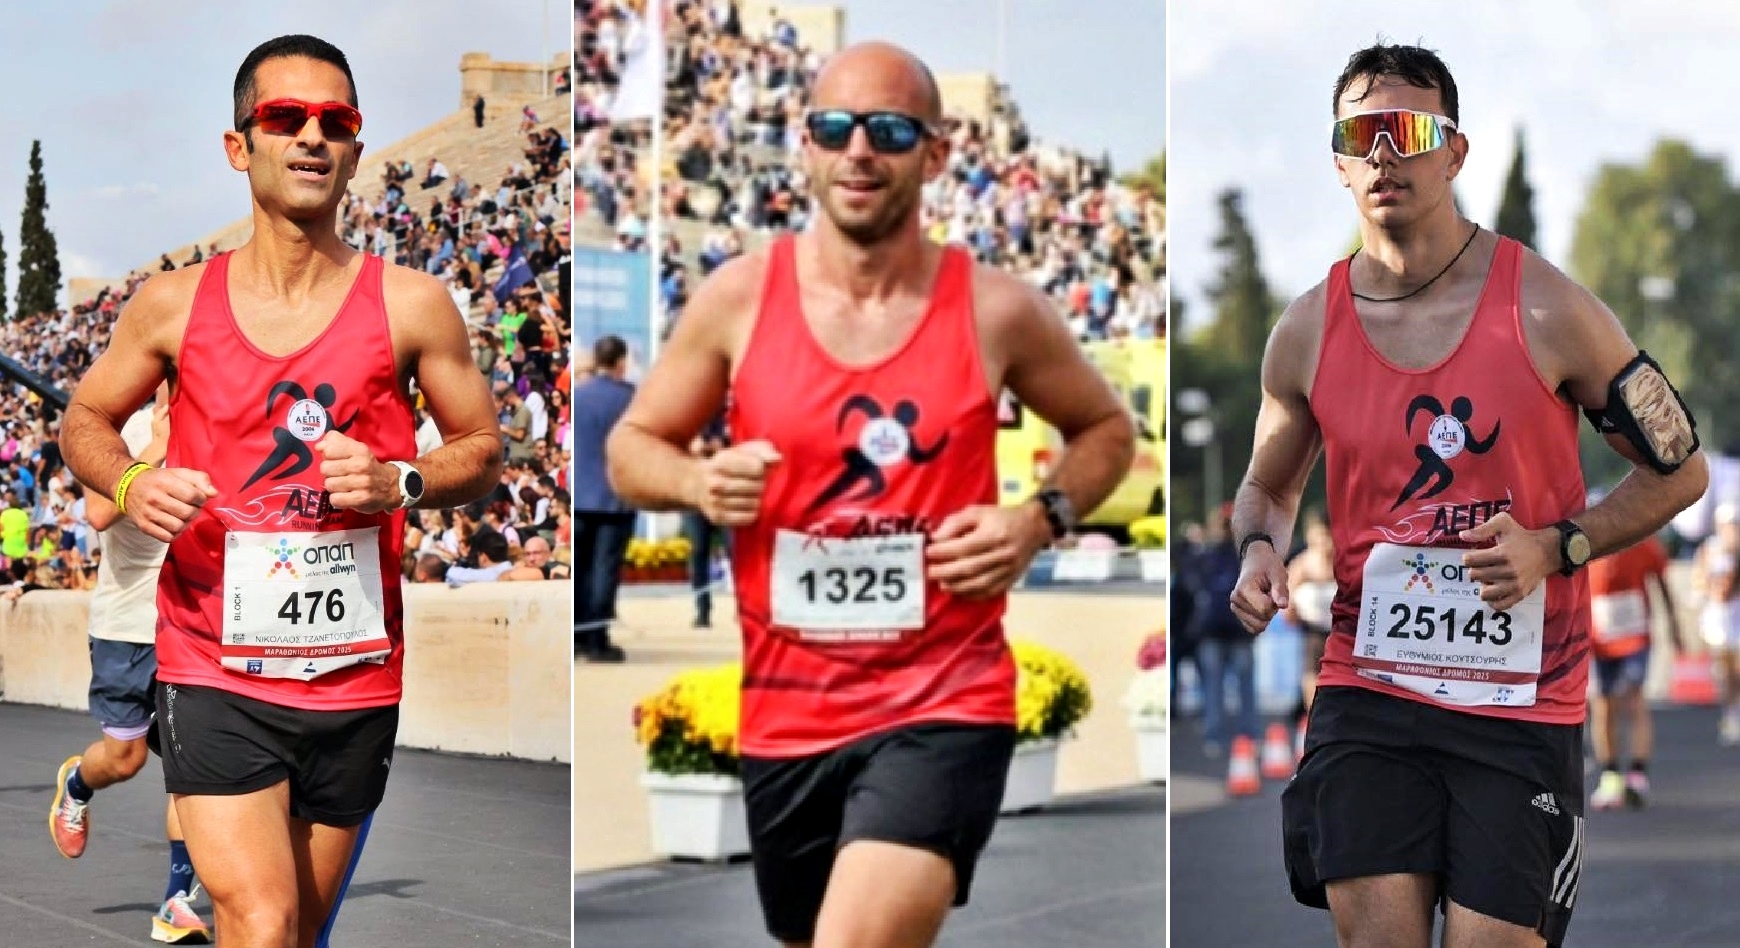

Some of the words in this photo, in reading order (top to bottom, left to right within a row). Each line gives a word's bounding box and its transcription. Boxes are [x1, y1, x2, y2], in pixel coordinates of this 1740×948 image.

[330, 563, 356, 575] allwyn
[797, 566, 907, 604] 1325
[277, 588, 345, 625] 476
[1367, 608, 1376, 637] BLOCK
[1386, 603, 1512, 646] 25143
[255, 635, 301, 644] ΝΙΚΟΛΑΟΣ
[264, 648, 308, 656] ΜΑΡΑΘΩΝΙΟΣ
[309, 647, 336, 656] ΔΡΟΜΟΣ
